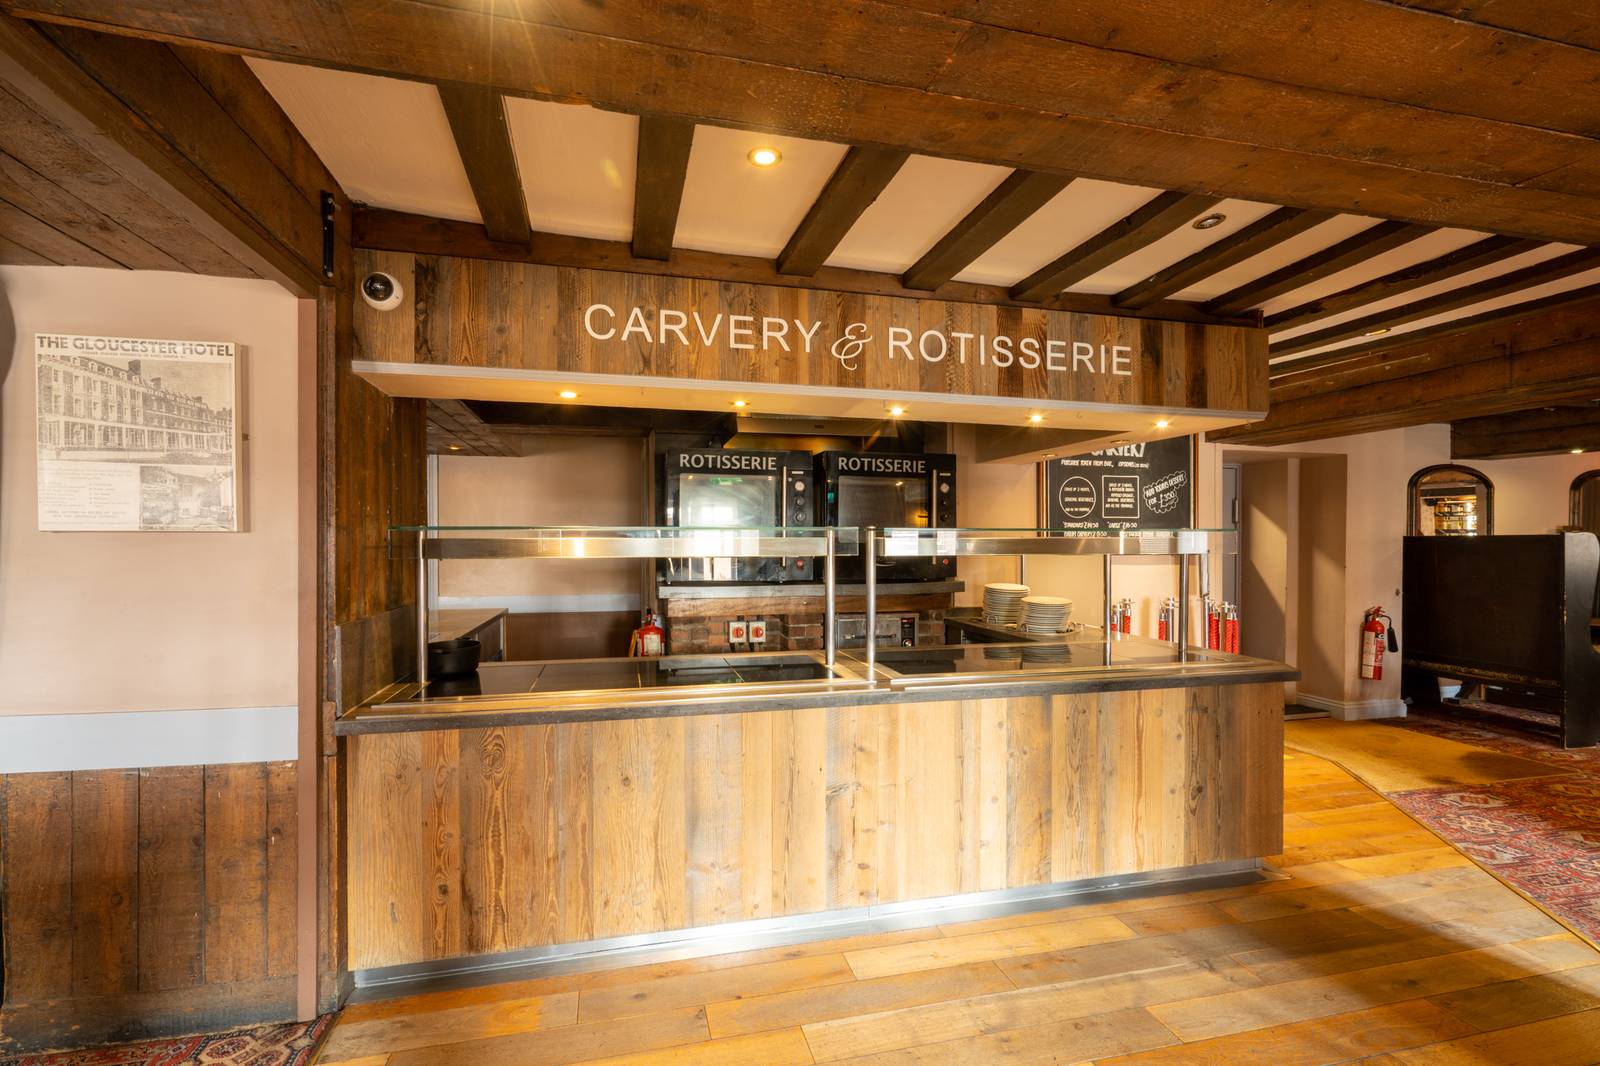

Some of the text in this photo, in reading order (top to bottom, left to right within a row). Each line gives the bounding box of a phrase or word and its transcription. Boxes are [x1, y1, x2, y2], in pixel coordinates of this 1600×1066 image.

[36, 336, 69, 350] THE
[72, 338, 177, 355] GLOUCESTER
[182, 343, 234, 357] HOTEL
[583, 303, 1132, 376] CARVERY & ROTISSERIE
[679, 453, 777, 471] ROTISSERIE
[838, 456, 926, 474] ROTISSERIE
